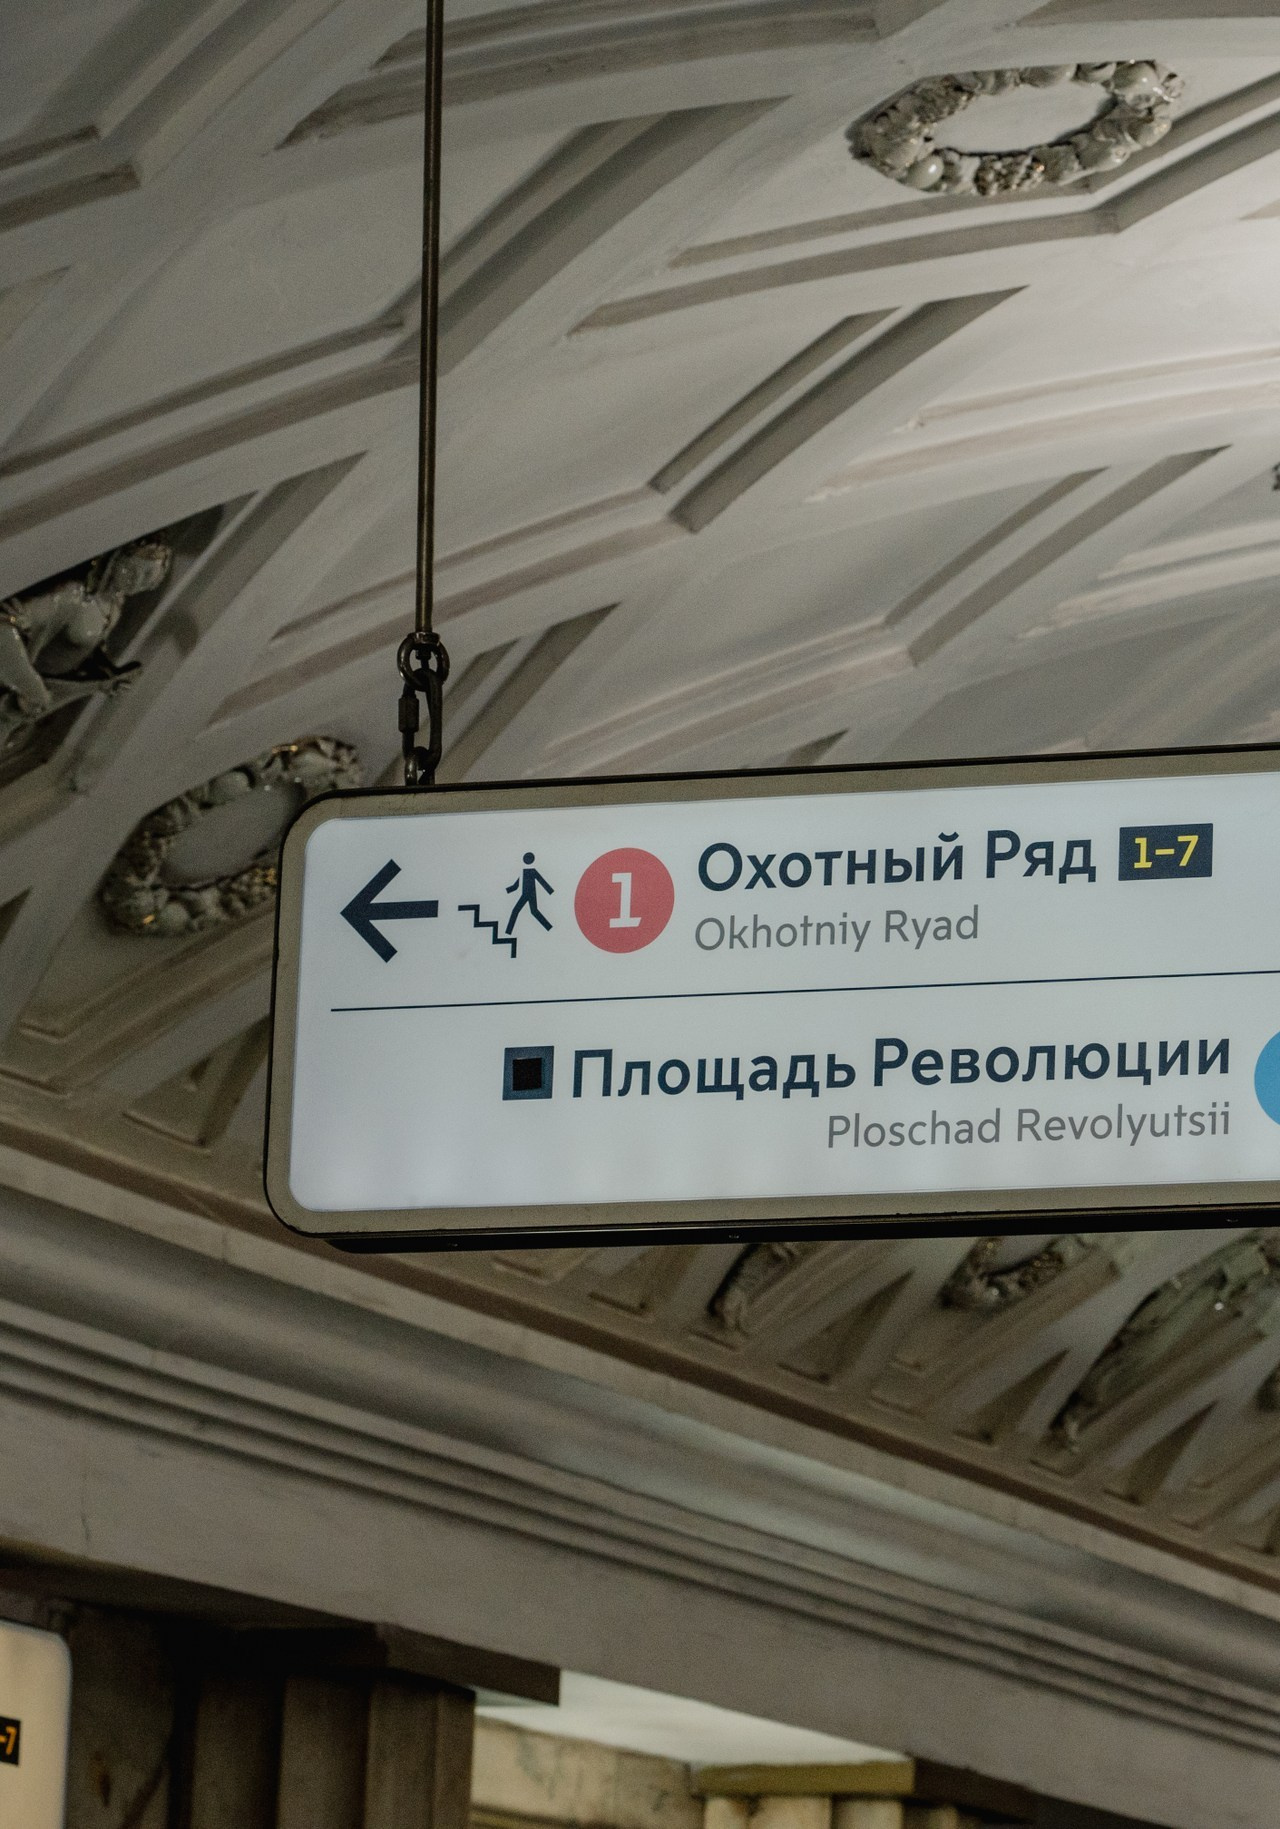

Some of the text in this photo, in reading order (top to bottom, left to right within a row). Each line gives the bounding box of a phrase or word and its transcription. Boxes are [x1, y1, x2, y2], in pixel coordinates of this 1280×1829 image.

[608, 872, 643, 929] 1
[697, 831, 965, 892] Охотный
[985, 829, 1098, 885] Ряд
[694, 904, 980, 954] Okhotniy Ryad
[572, 1048, 858, 1102] Площадь
[873, 1037, 1231, 1087] Революции
[827, 1101, 1231, 1150] Ploschad Revolyutsii
